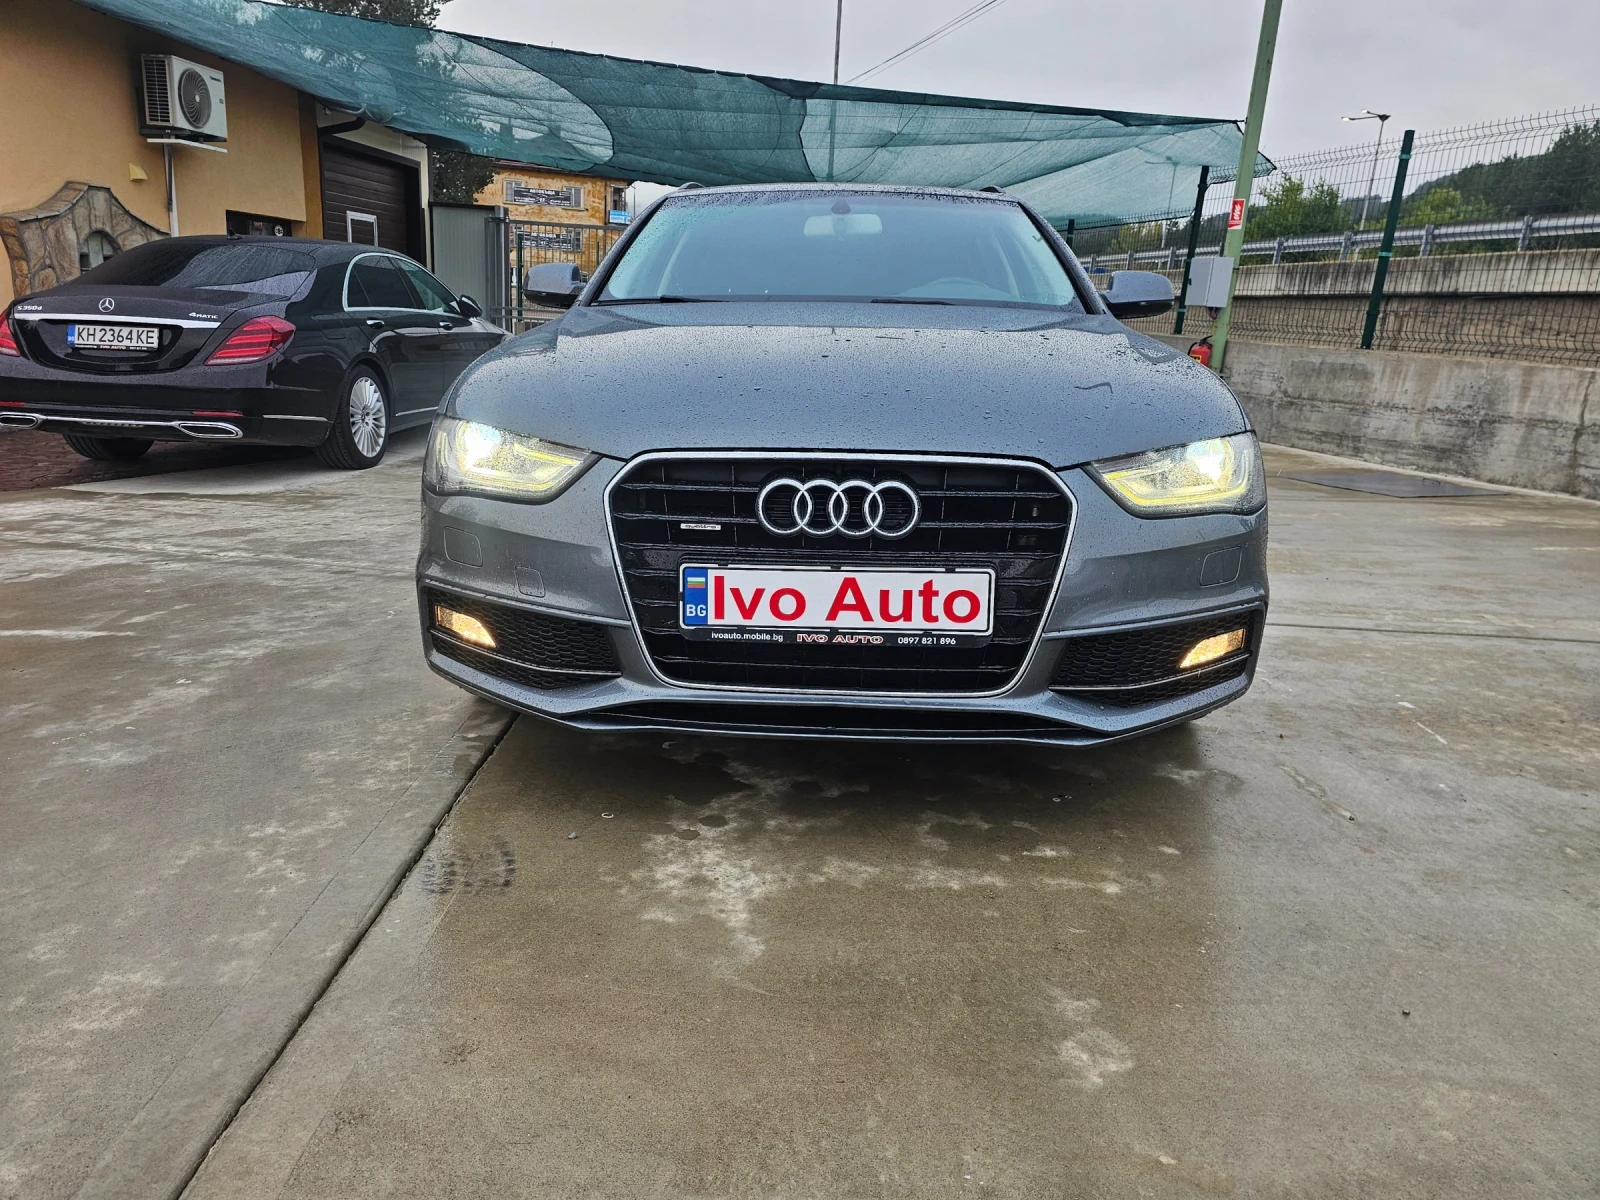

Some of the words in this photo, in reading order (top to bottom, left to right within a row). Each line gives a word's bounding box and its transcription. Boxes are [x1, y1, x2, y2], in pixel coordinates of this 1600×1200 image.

[714, 575, 807, 622] Ivo
[825, 576, 981, 624] Auto
[686, 604, 707, 617] BG
[711, 631, 784, 642] ivoauto.mobile.bg
[796, 633, 829, 643] IVO
[832, 634, 884, 644] AUTO
[897, 636, 919, 645] 0897
[921, 637, 937, 645] 821
[939, 637, 957, 645] 896
